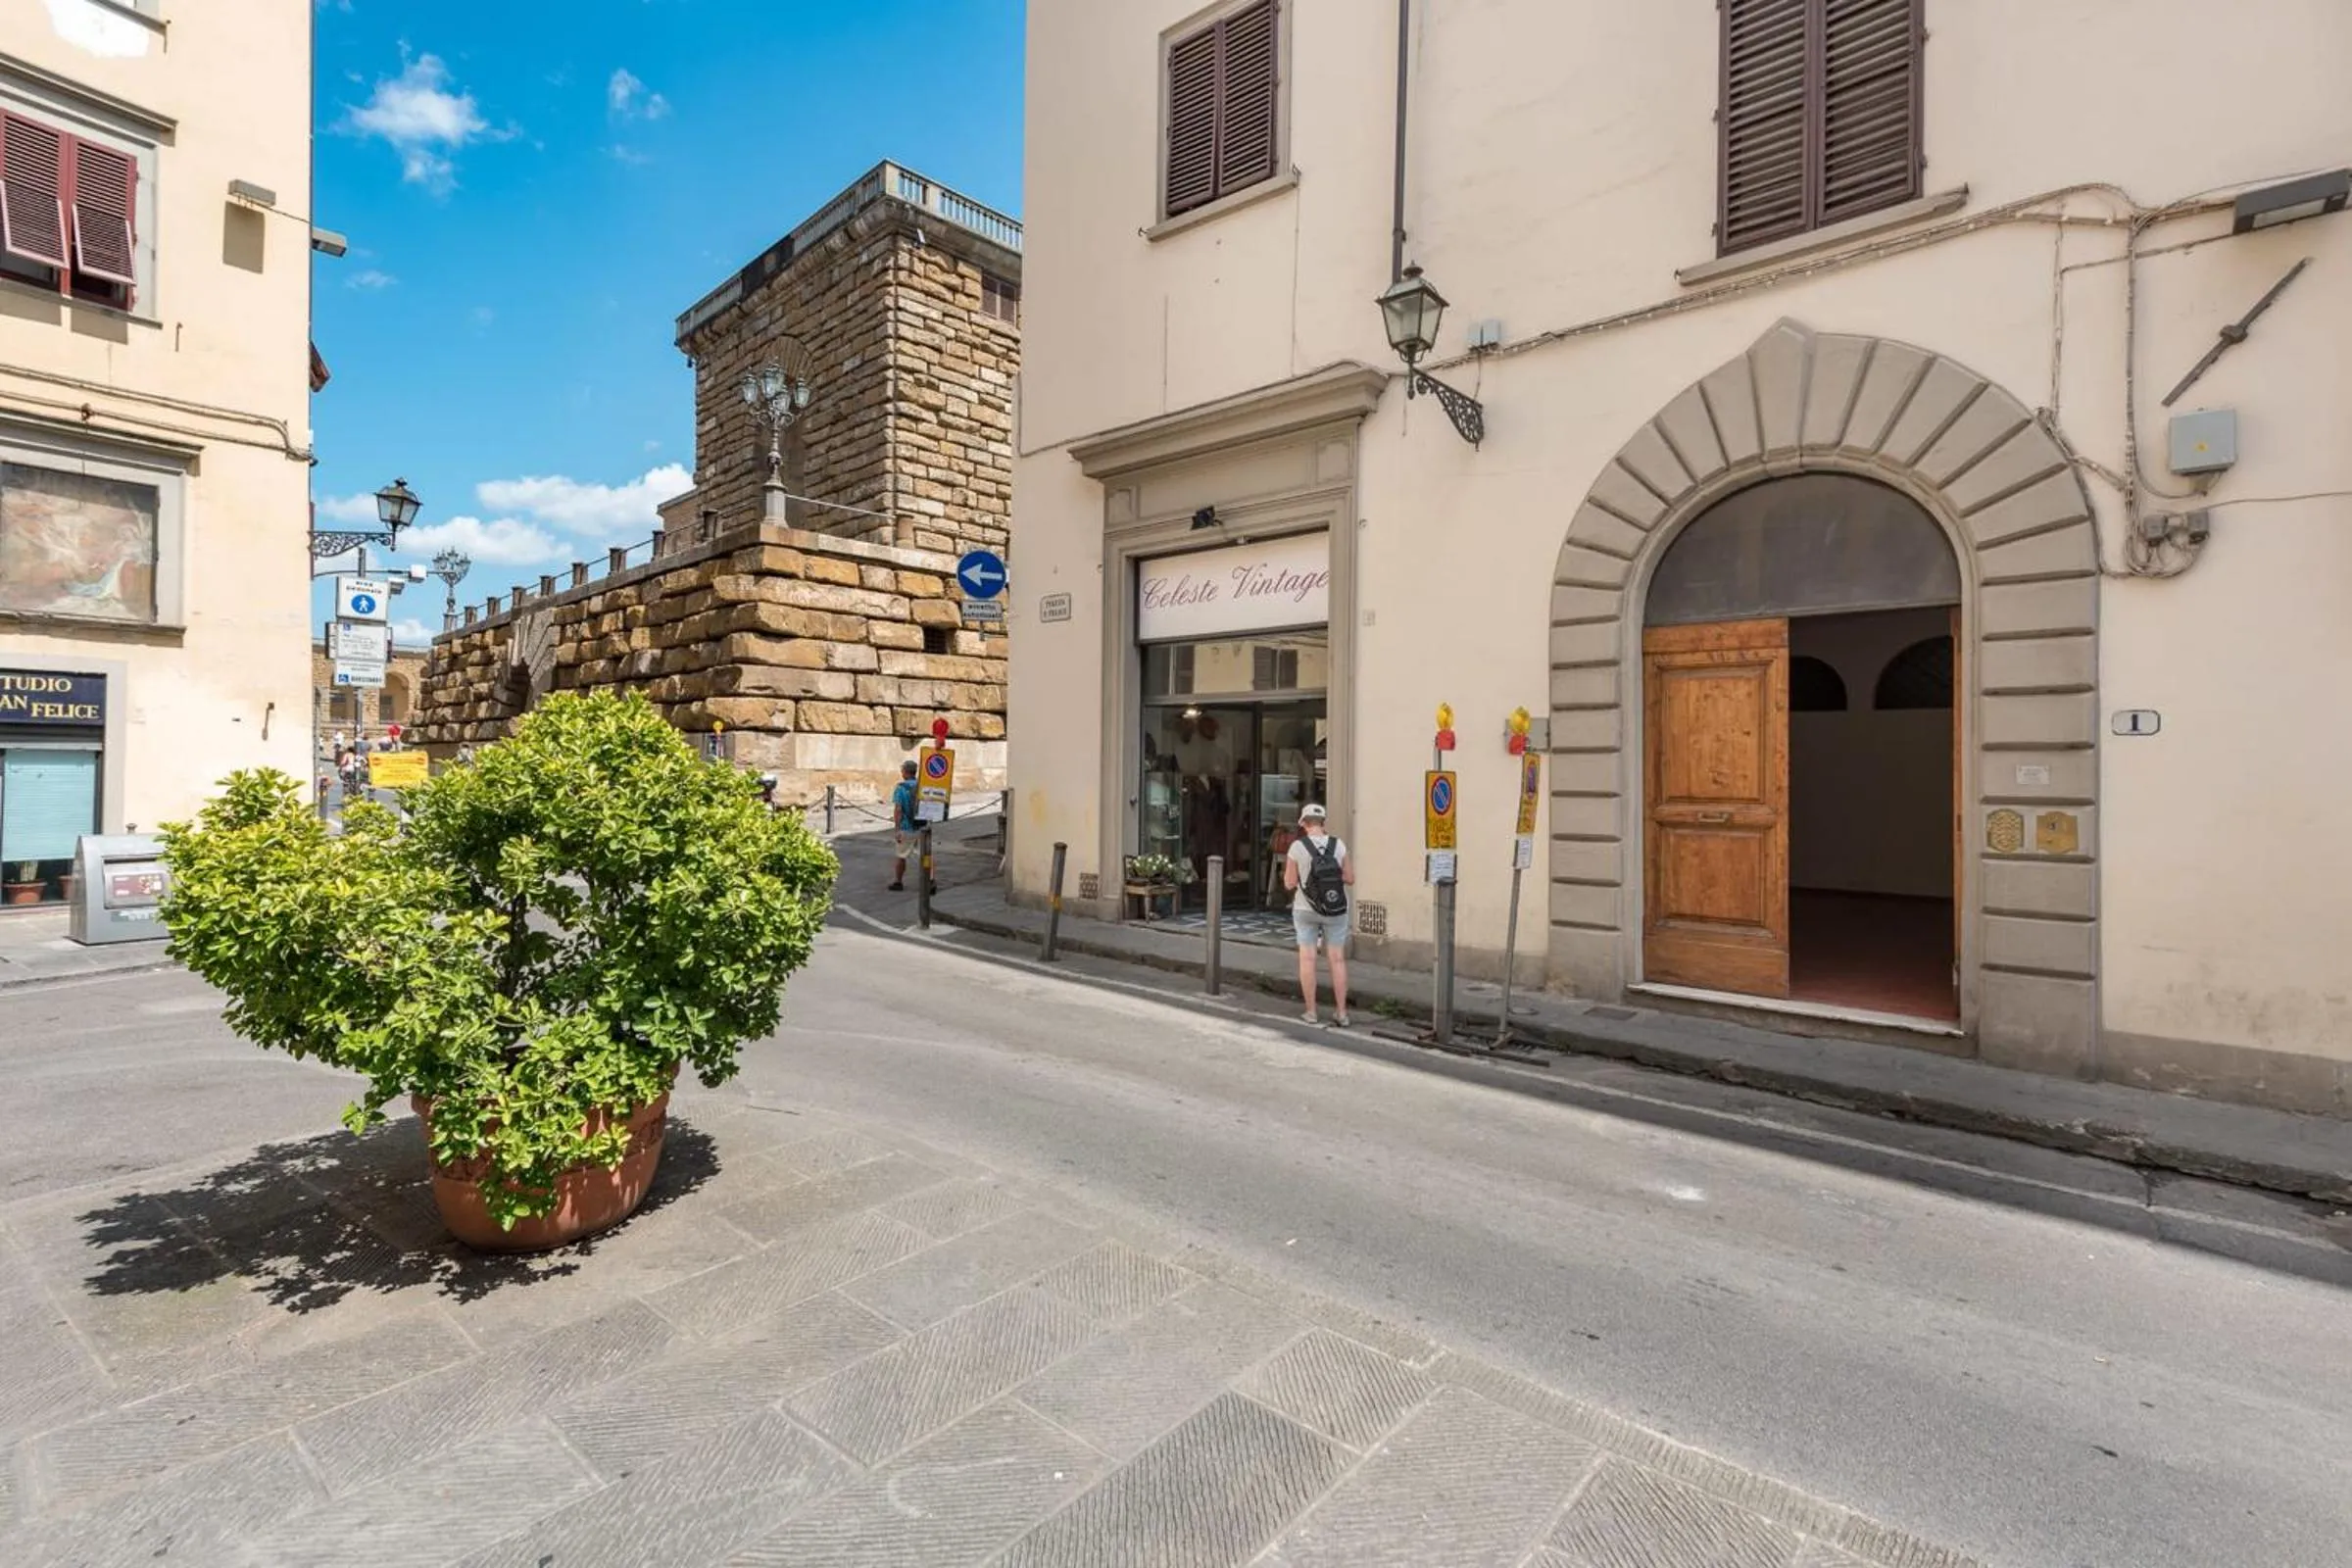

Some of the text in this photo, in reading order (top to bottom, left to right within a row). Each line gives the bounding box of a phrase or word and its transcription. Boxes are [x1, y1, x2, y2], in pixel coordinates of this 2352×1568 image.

[1144, 563, 1330, 610] Celeste Vintage
[30, 702, 99, 718] FELICE
